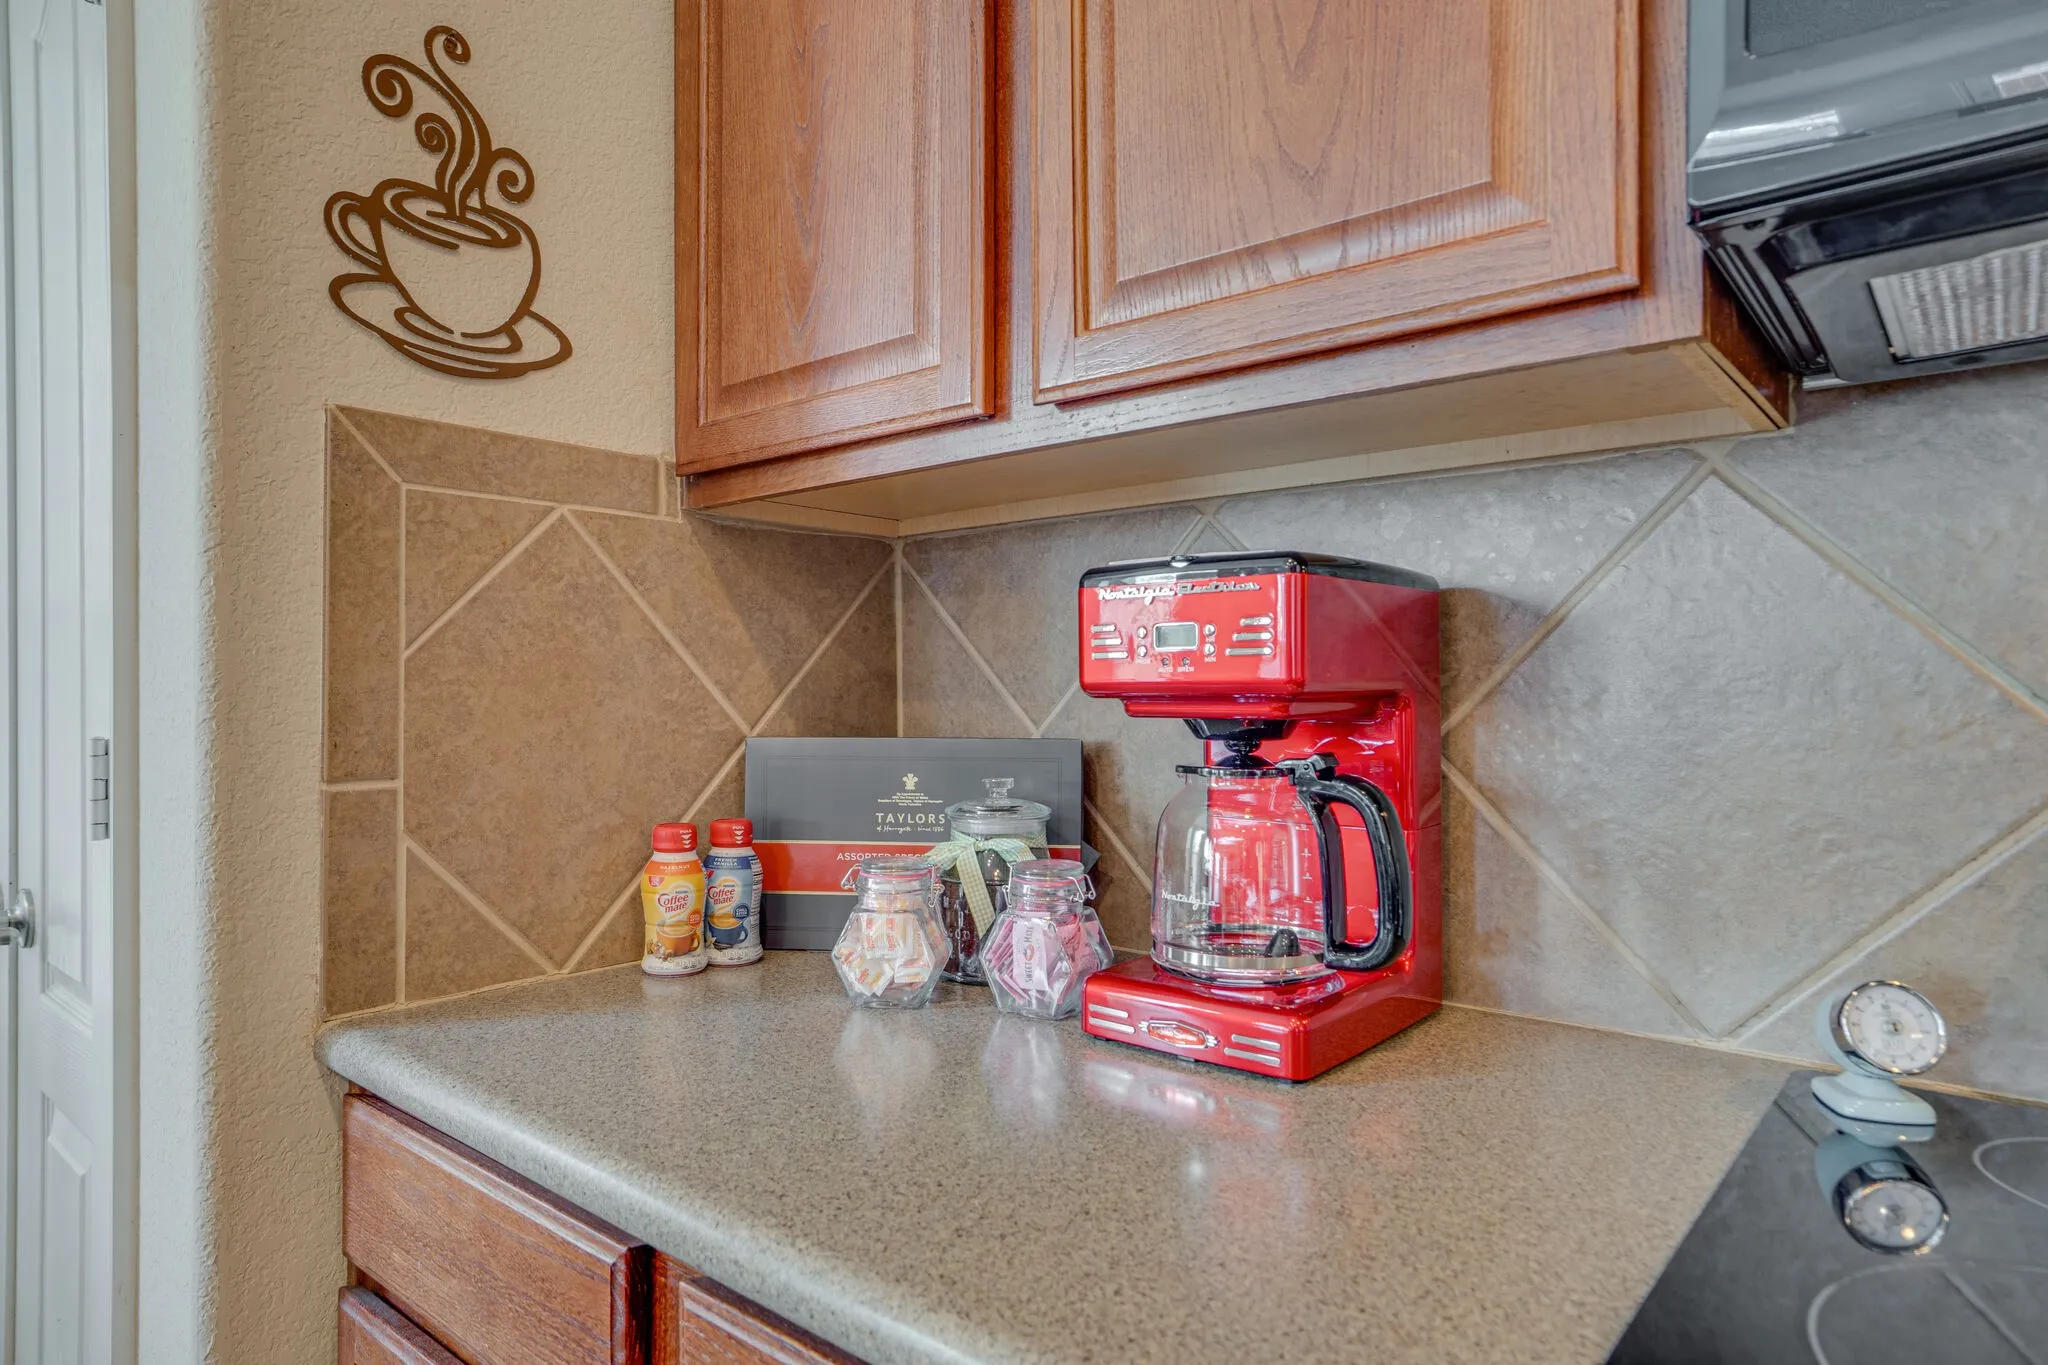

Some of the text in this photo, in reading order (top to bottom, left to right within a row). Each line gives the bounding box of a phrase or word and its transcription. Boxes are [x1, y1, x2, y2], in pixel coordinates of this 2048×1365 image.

[1098, 585, 1175, 606] Nostalgia
[875, 812, 946, 824] TAYLORS
[657, 892, 689, 908] Coffee
[707, 885, 736, 900] Coffee
[1161, 889, 1221, 911] Nostalgia
[664, 901, 689, 914] mate
[713, 895, 734, 906] mate
